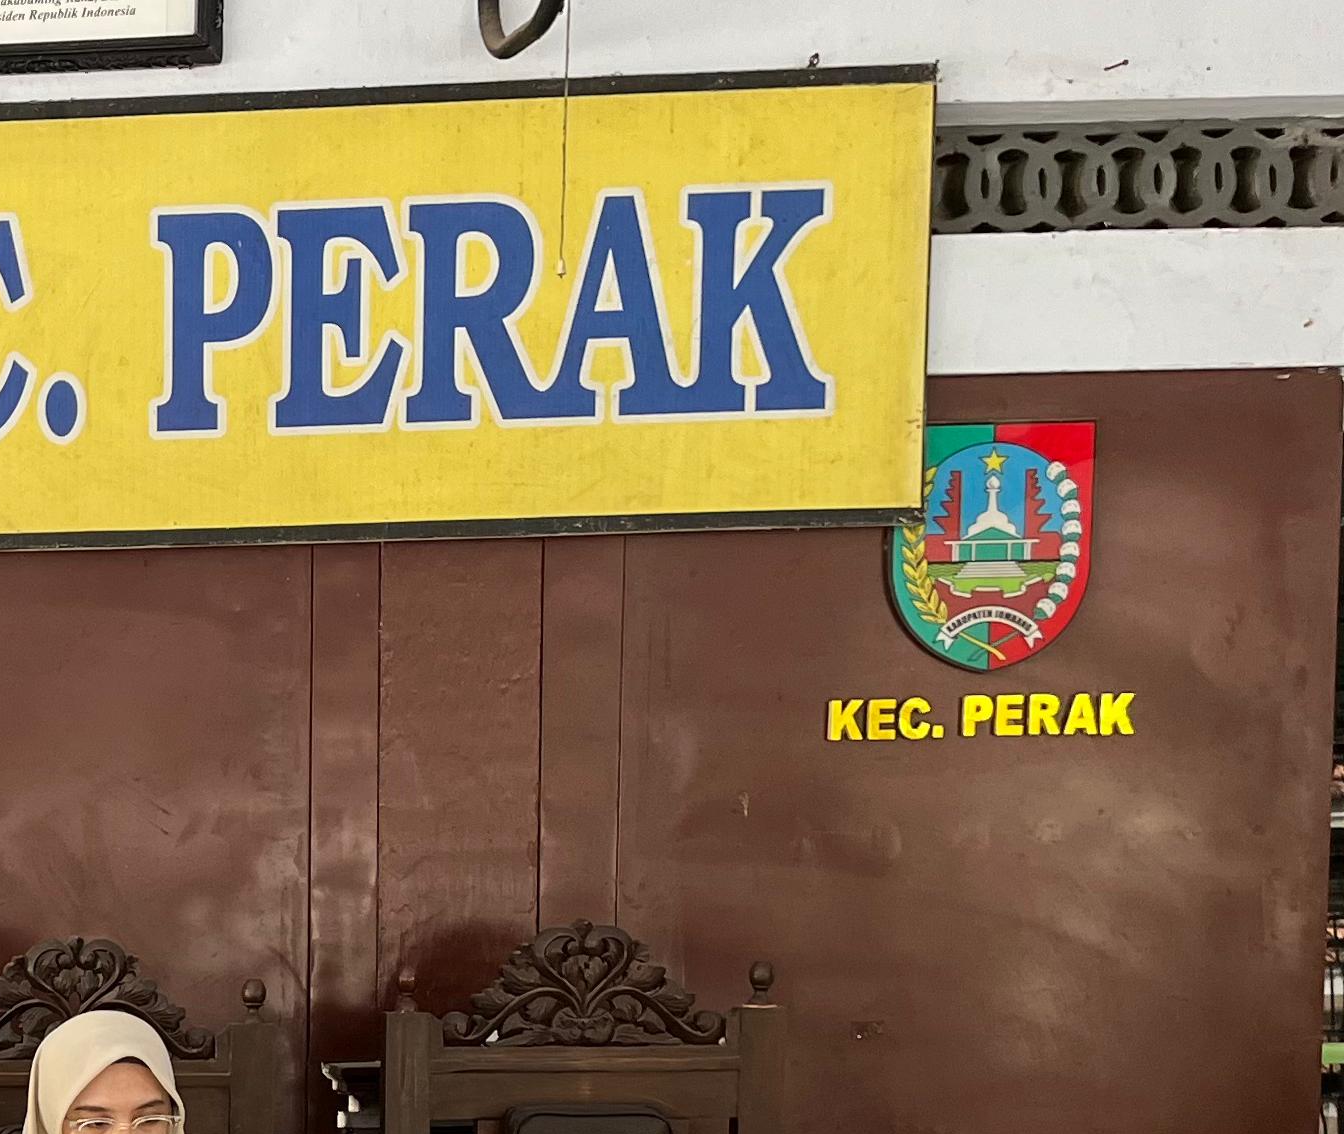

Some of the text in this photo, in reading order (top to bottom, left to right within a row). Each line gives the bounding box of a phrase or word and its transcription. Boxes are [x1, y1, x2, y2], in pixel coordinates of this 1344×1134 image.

[29, 7, 78, 22] Republik
[81, 5, 136, 17] Indonesia
[156, 188, 826, 432] PERAK
[827, 692, 1135, 741] KEC. PERAK
